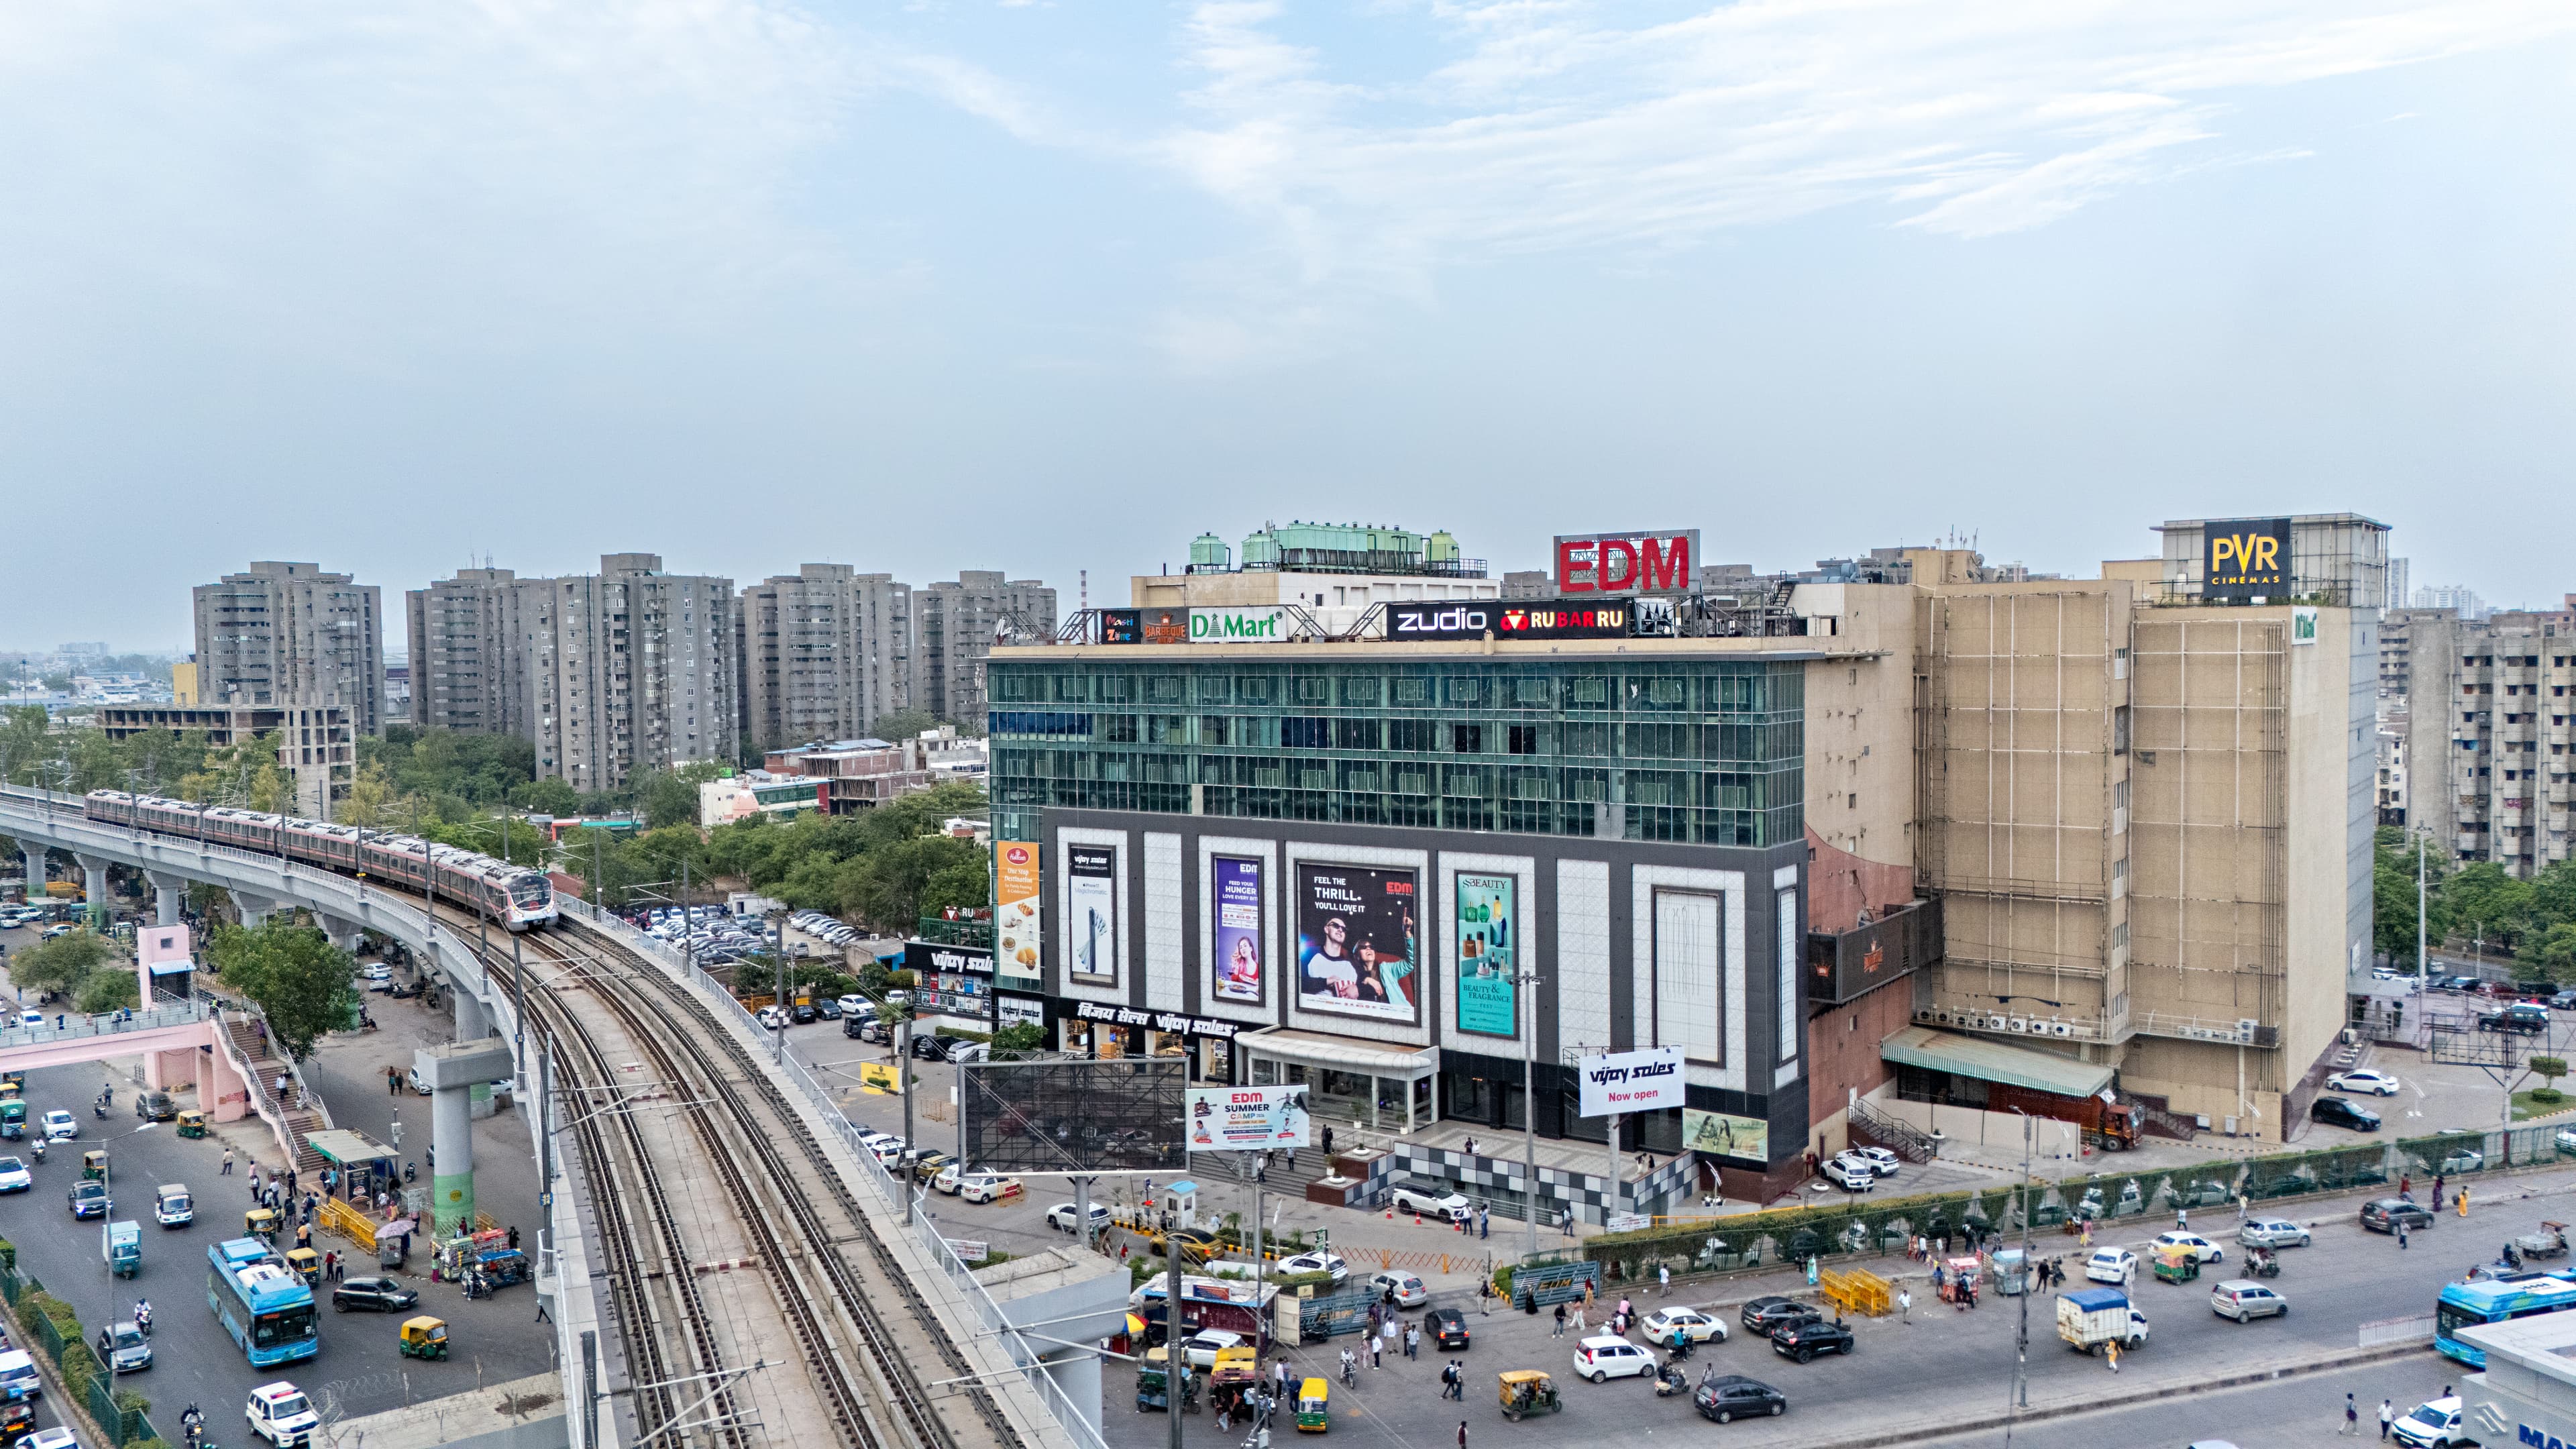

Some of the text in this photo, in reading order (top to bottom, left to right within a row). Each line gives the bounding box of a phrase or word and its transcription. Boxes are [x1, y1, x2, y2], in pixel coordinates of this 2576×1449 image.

[2212, 533, 2279, 574] PVR
[1560, 537, 1688, 592] EDM
[2212, 576, 2279, 585] CINEMAS
[1106, 614, 1133, 627] Masti
[1397, 608, 1487, 631] zudio
[1144, 624, 1186, 638] BARBEQUE
[1074, 855, 1089, 864] vijay
[1314, 876, 1346, 885] FEEL THE
[1226, 885, 1256, 895] HUNGER
[1386, 881, 1413, 894] EDM
[1315, 902, 1338, 910] YOU'LL
[1339, 904, 1357, 912] LOVE
[931, 951, 966, 972] vijay
[1463, 983, 1499, 993] BEAUTY &
[1468, 992, 1510, 1003] FRAGRANCE
[1077, 1002, 1116, 1021] विजय
[1156, 1014, 1234, 1037] vijay sales
[1589, 1061, 1676, 1085] vijay sales
[1232, 1092, 1263, 1104] EDM
[1608, 1089, 1658, 1102] Now open
[1225, 1104, 1270, 1112] SUMMER
